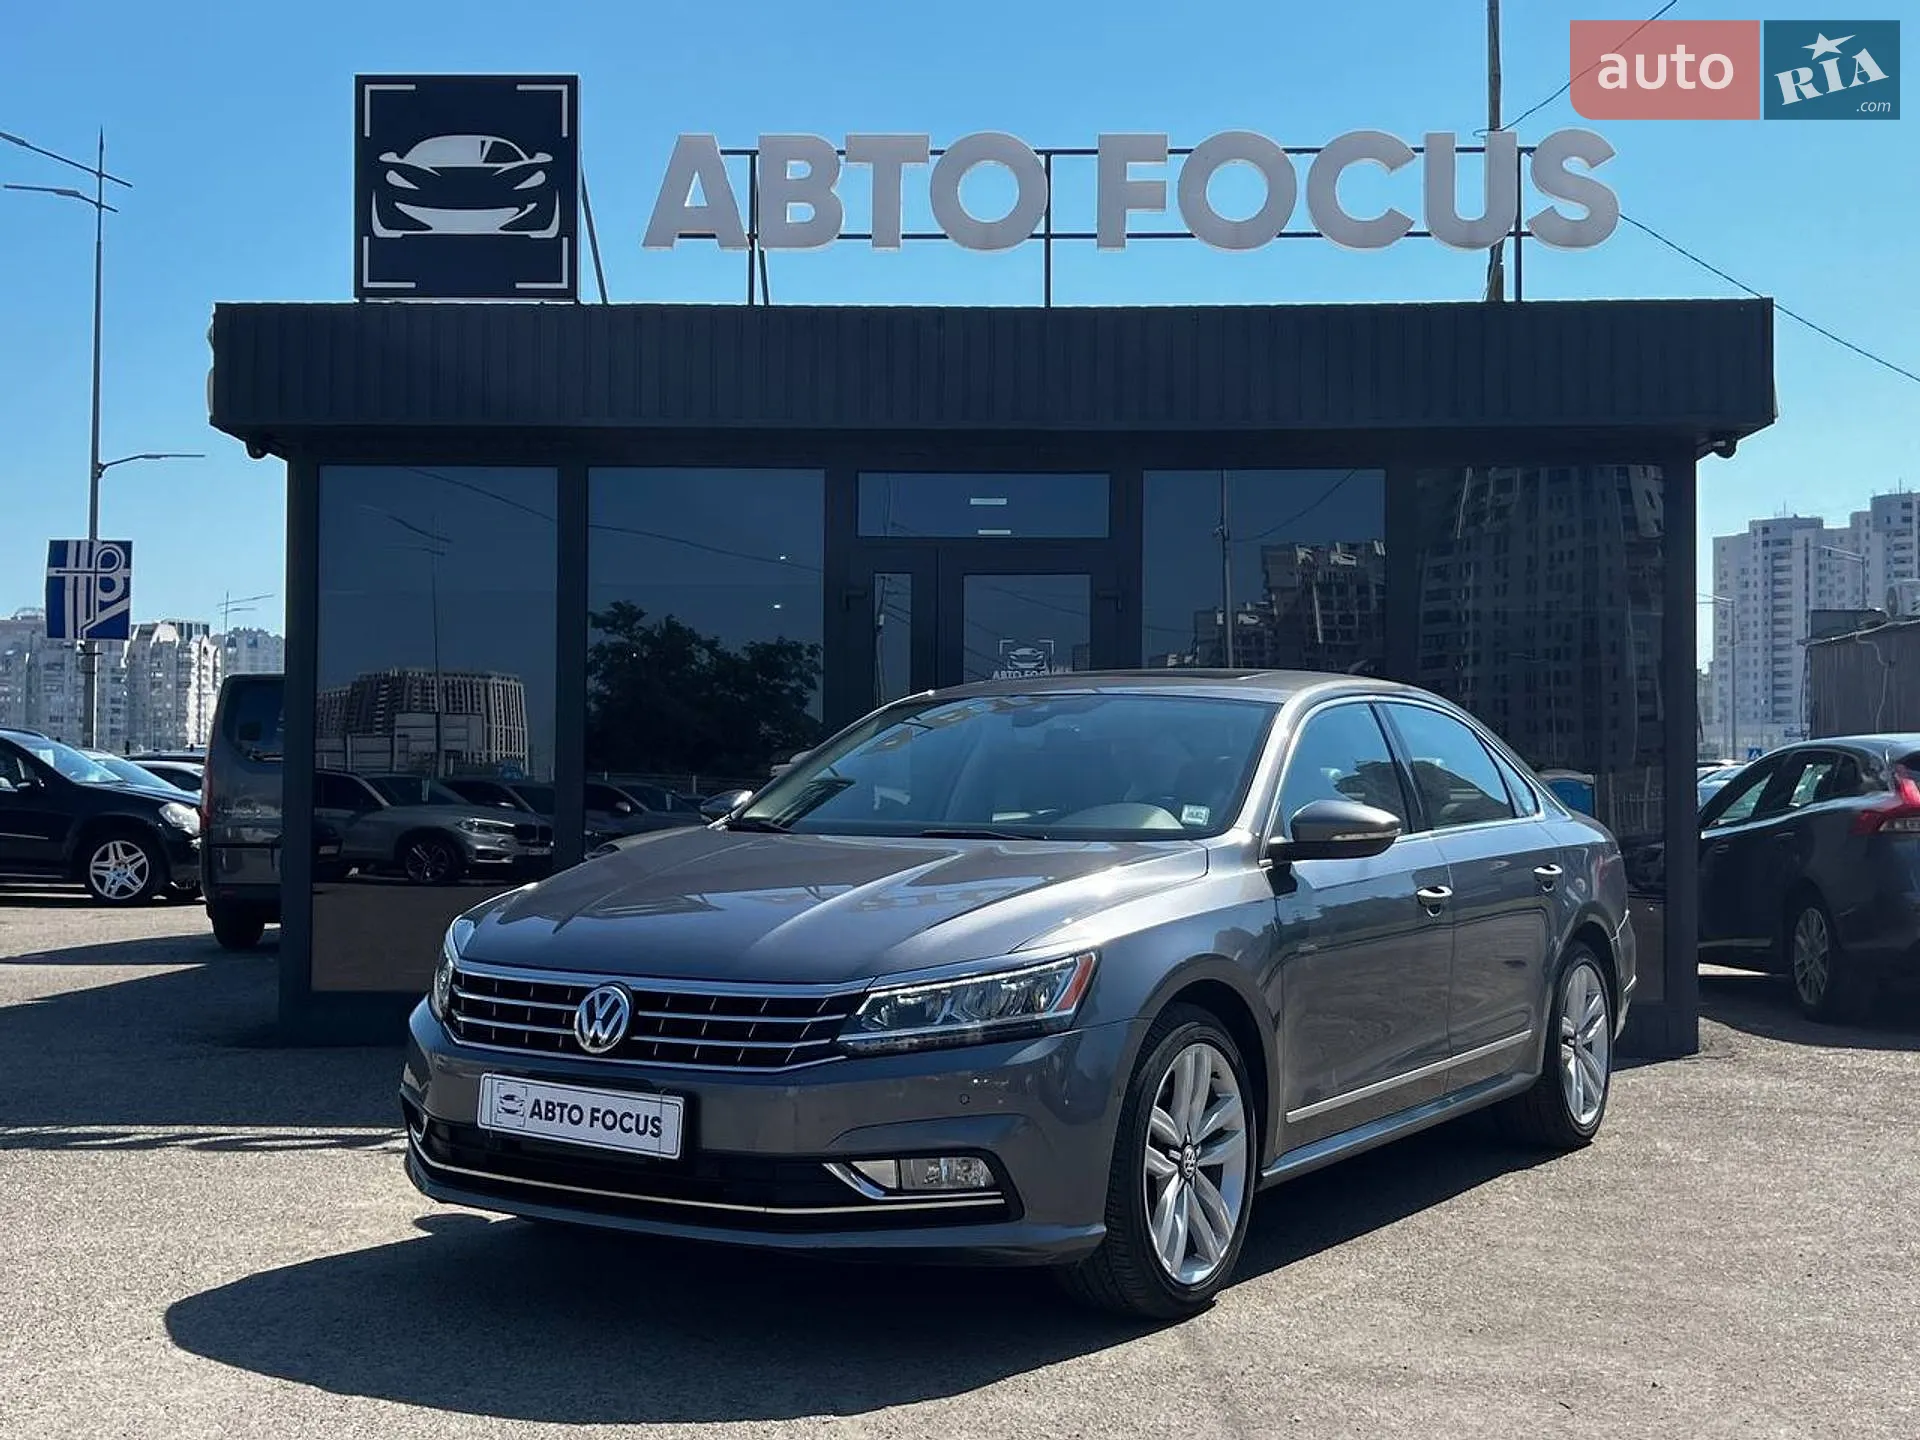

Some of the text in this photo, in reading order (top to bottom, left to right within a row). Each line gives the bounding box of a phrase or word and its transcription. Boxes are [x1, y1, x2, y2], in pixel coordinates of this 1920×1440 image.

[642, 130, 1620, 252] АВТО FOCUS
[529, 1098, 663, 1139] АВТО FOCUS
